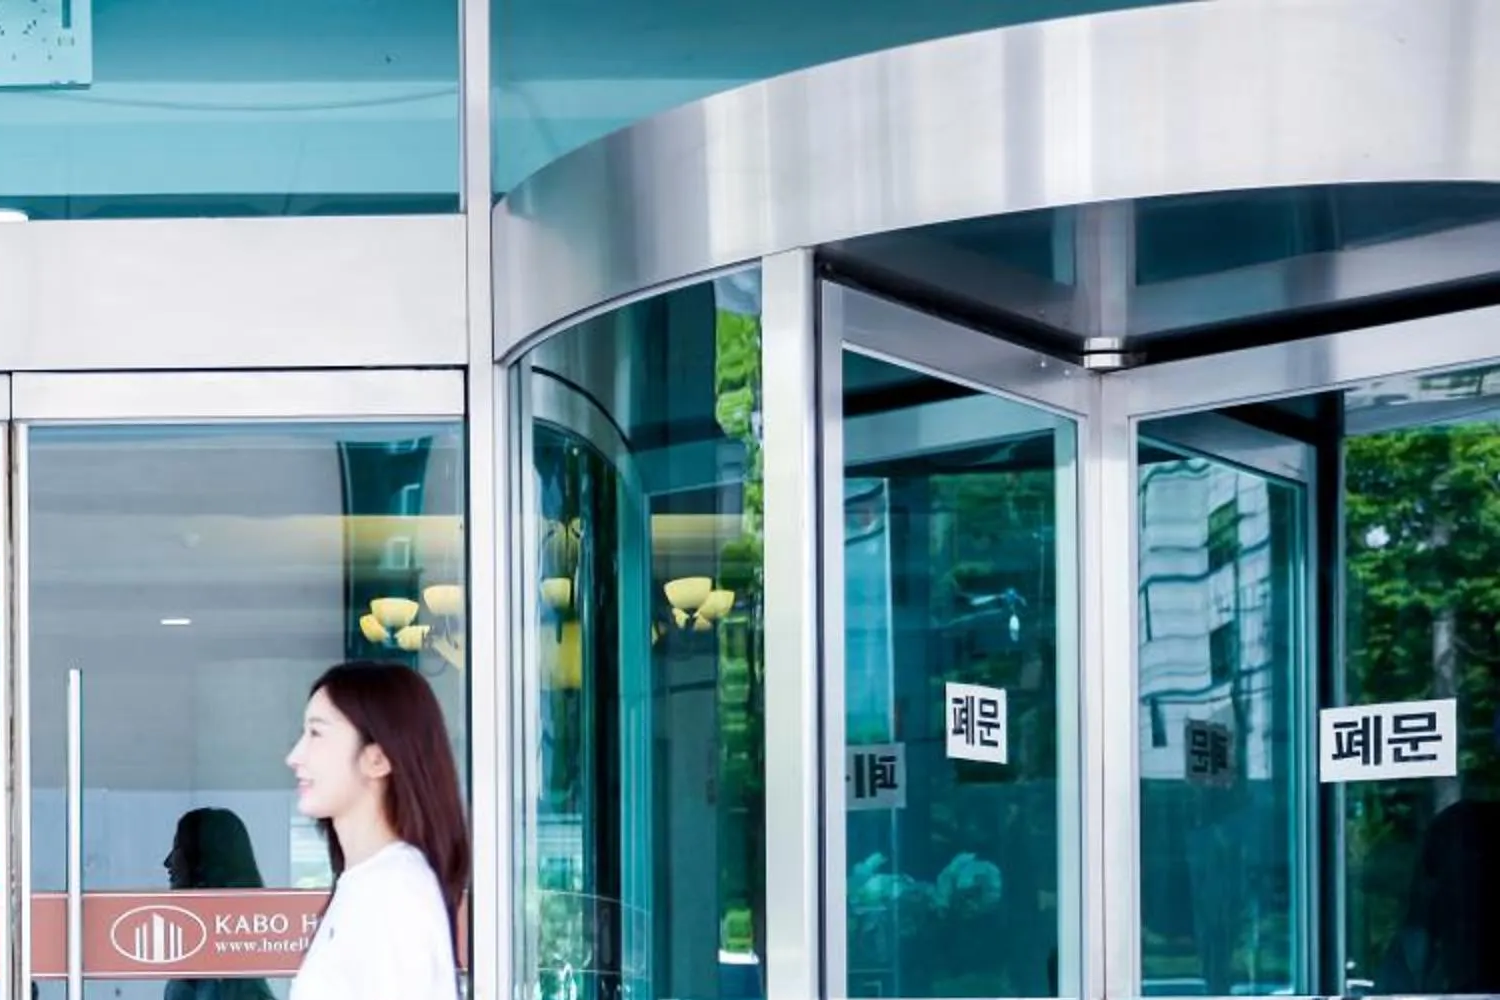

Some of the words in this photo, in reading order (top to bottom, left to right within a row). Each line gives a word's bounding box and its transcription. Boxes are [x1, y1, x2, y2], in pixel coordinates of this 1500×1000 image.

[952, 695, 1001, 748] 폐문
[1331, 711, 1443, 767] 폐문
[214, 912, 290, 935] KABO
